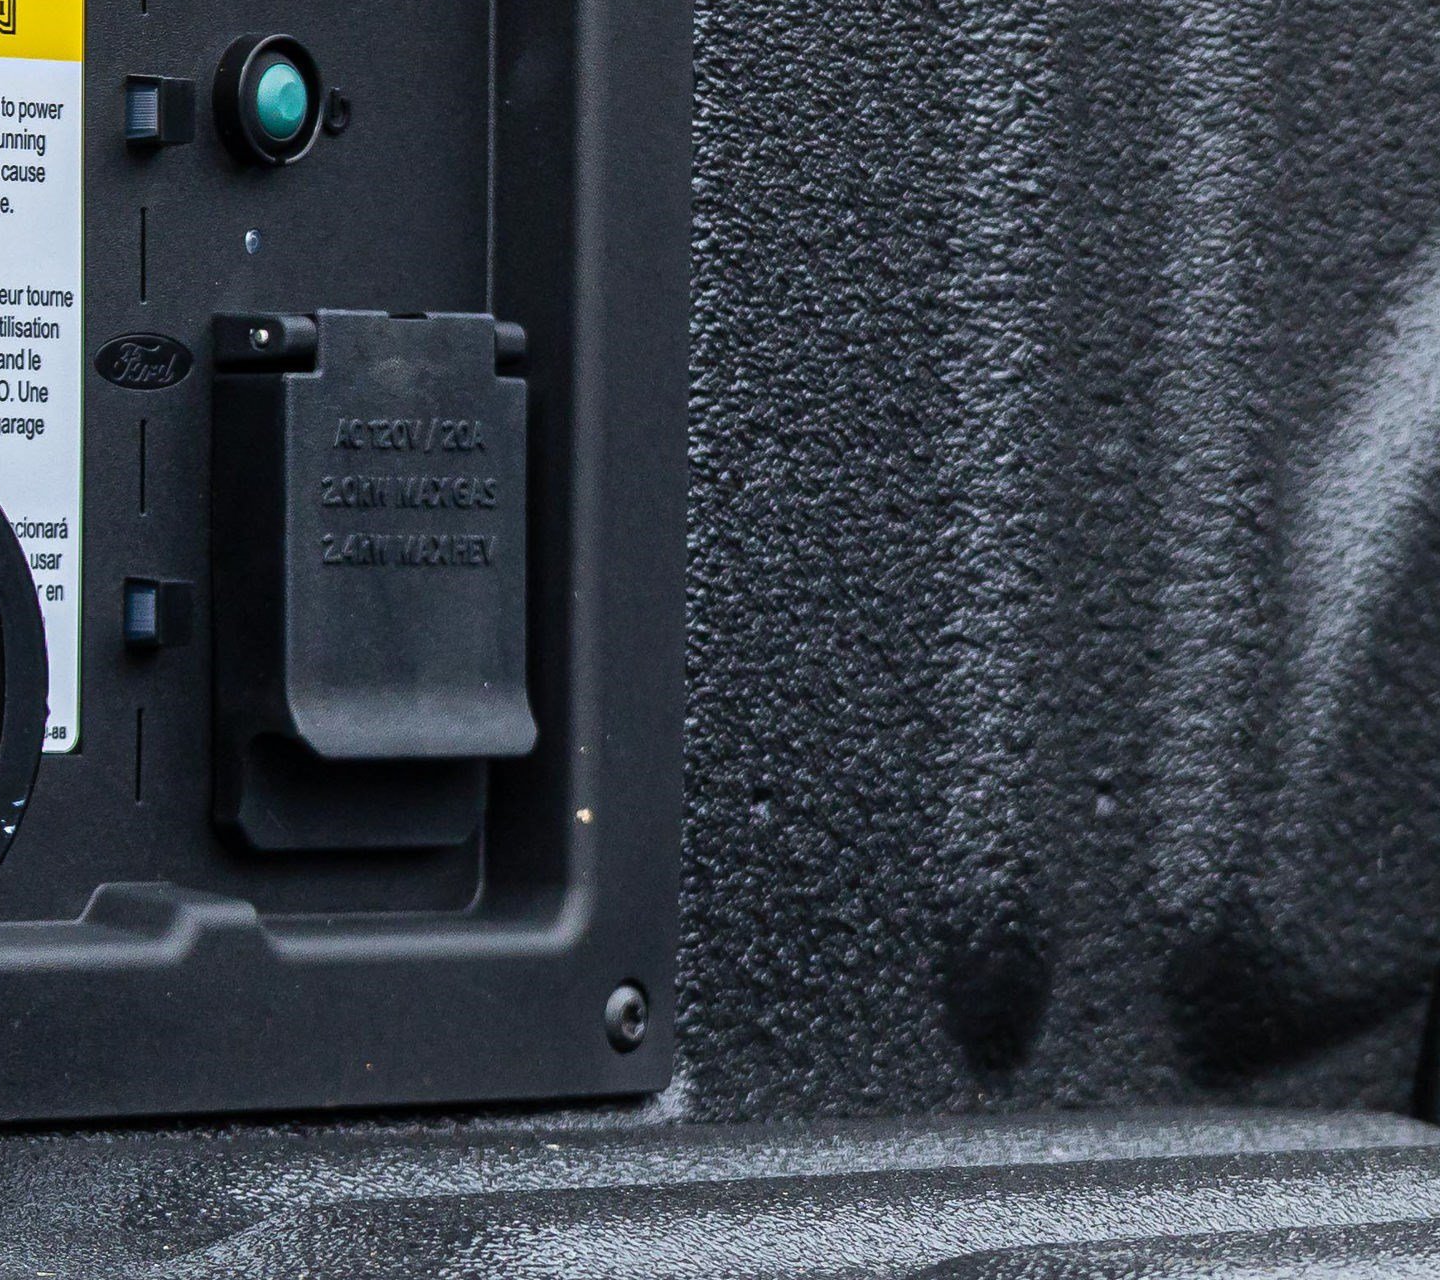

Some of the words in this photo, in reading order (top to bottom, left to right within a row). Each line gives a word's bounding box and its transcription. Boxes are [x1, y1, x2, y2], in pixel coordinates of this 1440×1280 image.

[1, 96, 16, 117] to
[18, 101, 64, 123] power
[0, 164, 46, 183] cause
[26, 285, 74, 308] tourne
[27, 348, 42, 371] le
[113, 342, 177, 383] Ford
[17, 380, 49, 403] Une
[332, 417, 364, 451] AC
[366, 418, 423, 451] 120V
[441, 419, 485, 452] 20A
[395, 475, 452, 509] MAX
[452, 476, 498, 509] GAS
[10, 516, 69, 539] cionará
[30, 552, 63, 571] usar
[395, 533, 452, 567] MAX
[451, 534, 497, 567] HEV
[45, 584, 64, 602] en
